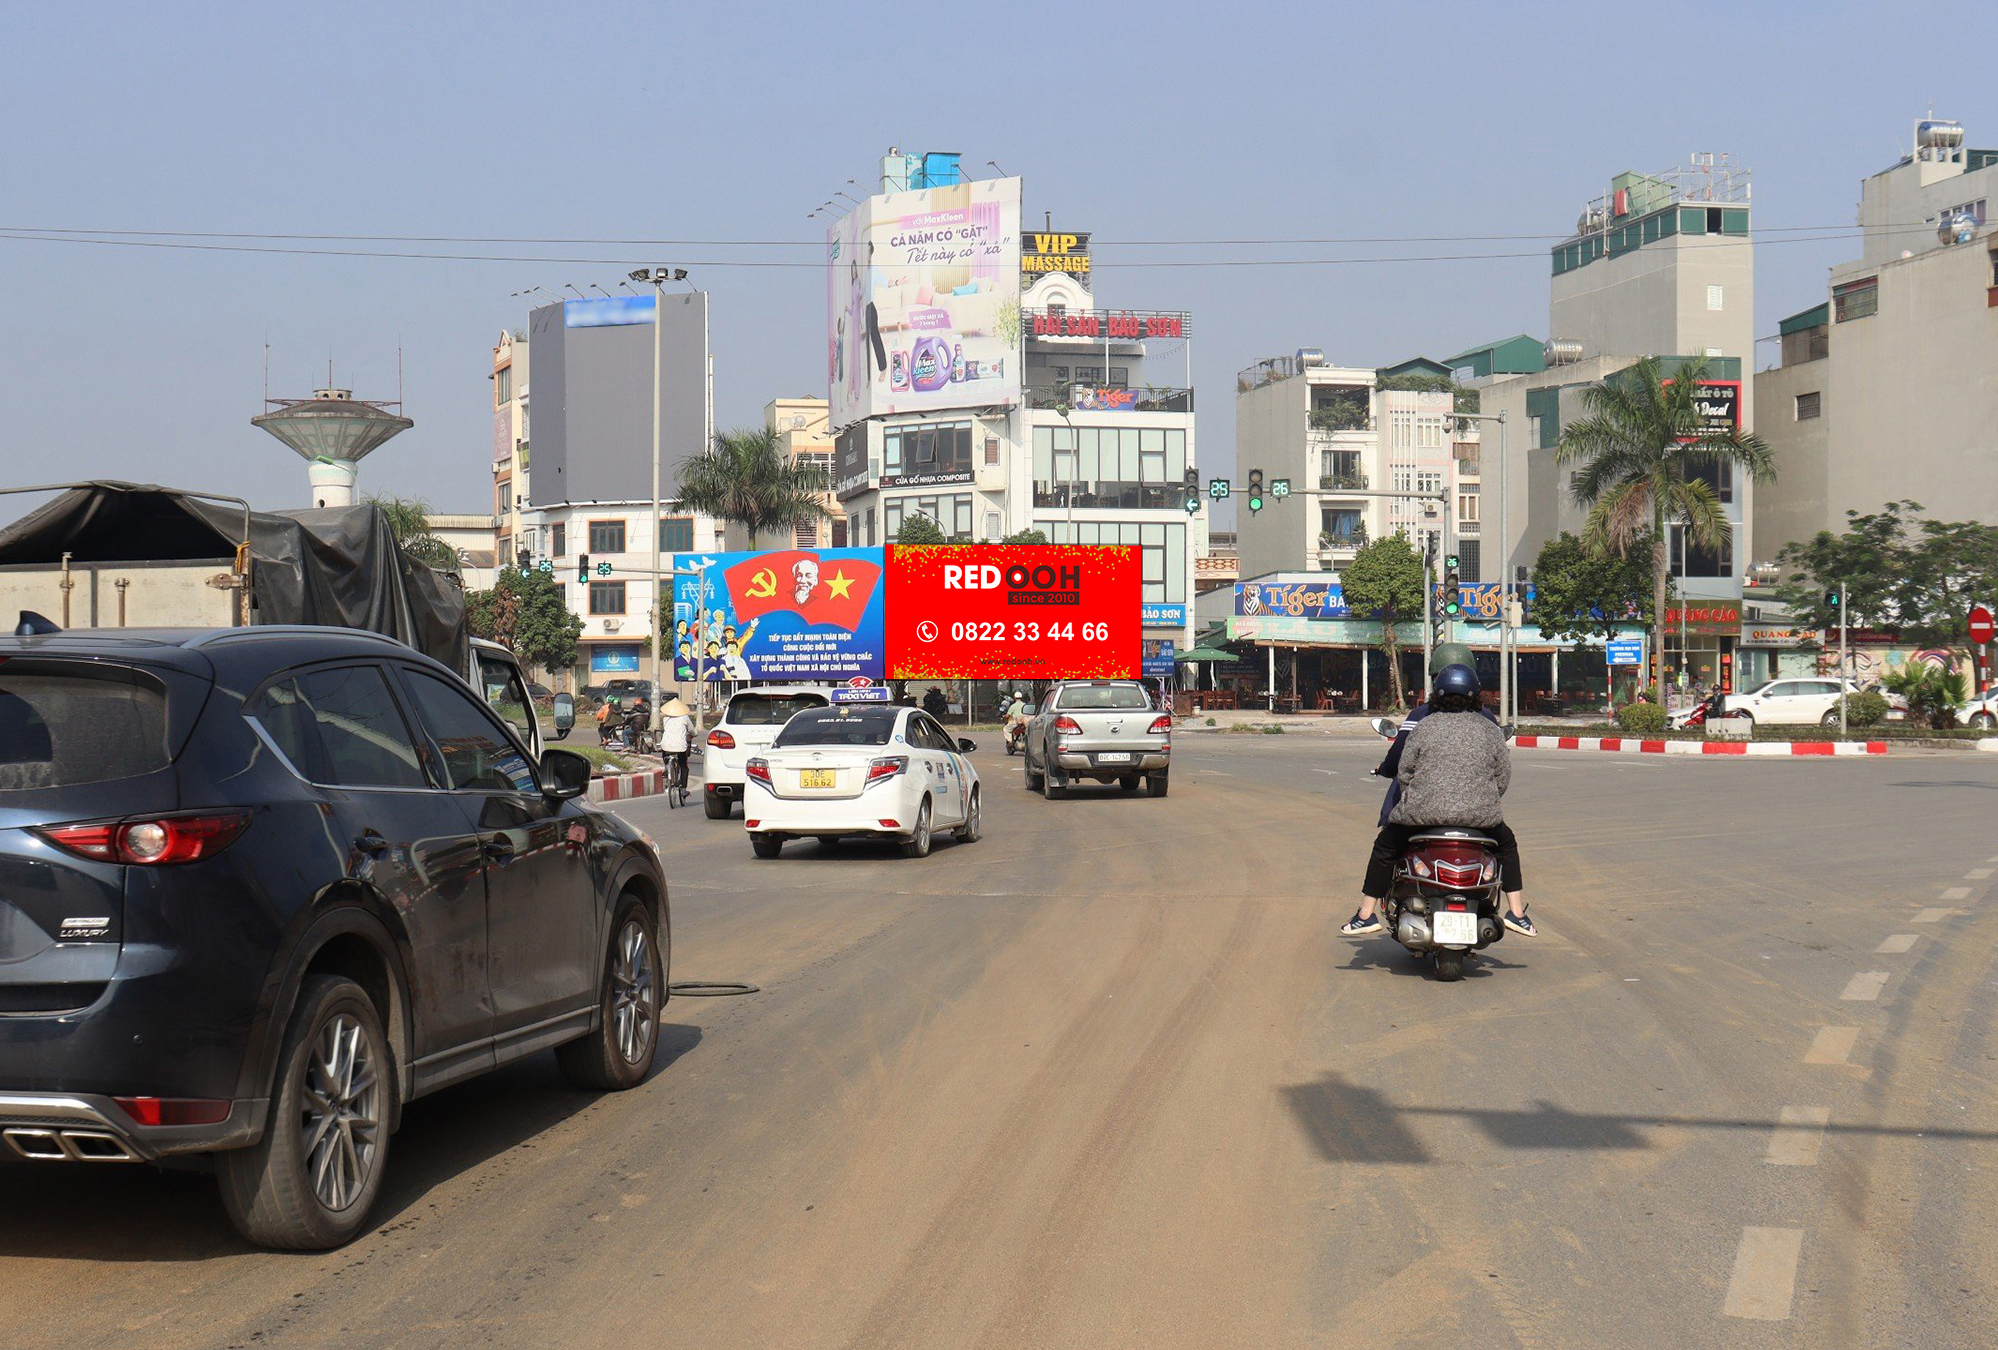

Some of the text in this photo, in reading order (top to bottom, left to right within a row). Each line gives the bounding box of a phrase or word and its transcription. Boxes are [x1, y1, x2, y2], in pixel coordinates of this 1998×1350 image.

[924, 213, 964, 224] MaxKleen
[908, 231, 934, 246] NĂM
[936, 227, 953, 242] CÓ
[1034, 234, 1077, 254] VIP
[907, 246, 928, 264] Tết
[930, 246, 956, 264] này
[959, 242, 974, 257] có
[1022, 256, 1090, 272] MASSAGE
[1096, 388, 1134, 409] Tiger
[1701, 402, 1730, 416] Decal
[937, 473, 970, 483] COMPOSITE
[1211, 482, 1228, 496] 25
[1273, 482, 1289, 496] 26
[540, 562, 552, 572] 25
[598, 564, 611, 574] 25
[1447, 558, 1457, 567] 26
[1012, 592, 1075, 603] since 2010
[1266, 585, 1329, 616] Tiger
[951, 622, 1108, 641] 0822 33 44 66
[980, 658, 1046, 666] www.redooh.vn
[60, 929, 110, 938] LUXURY
